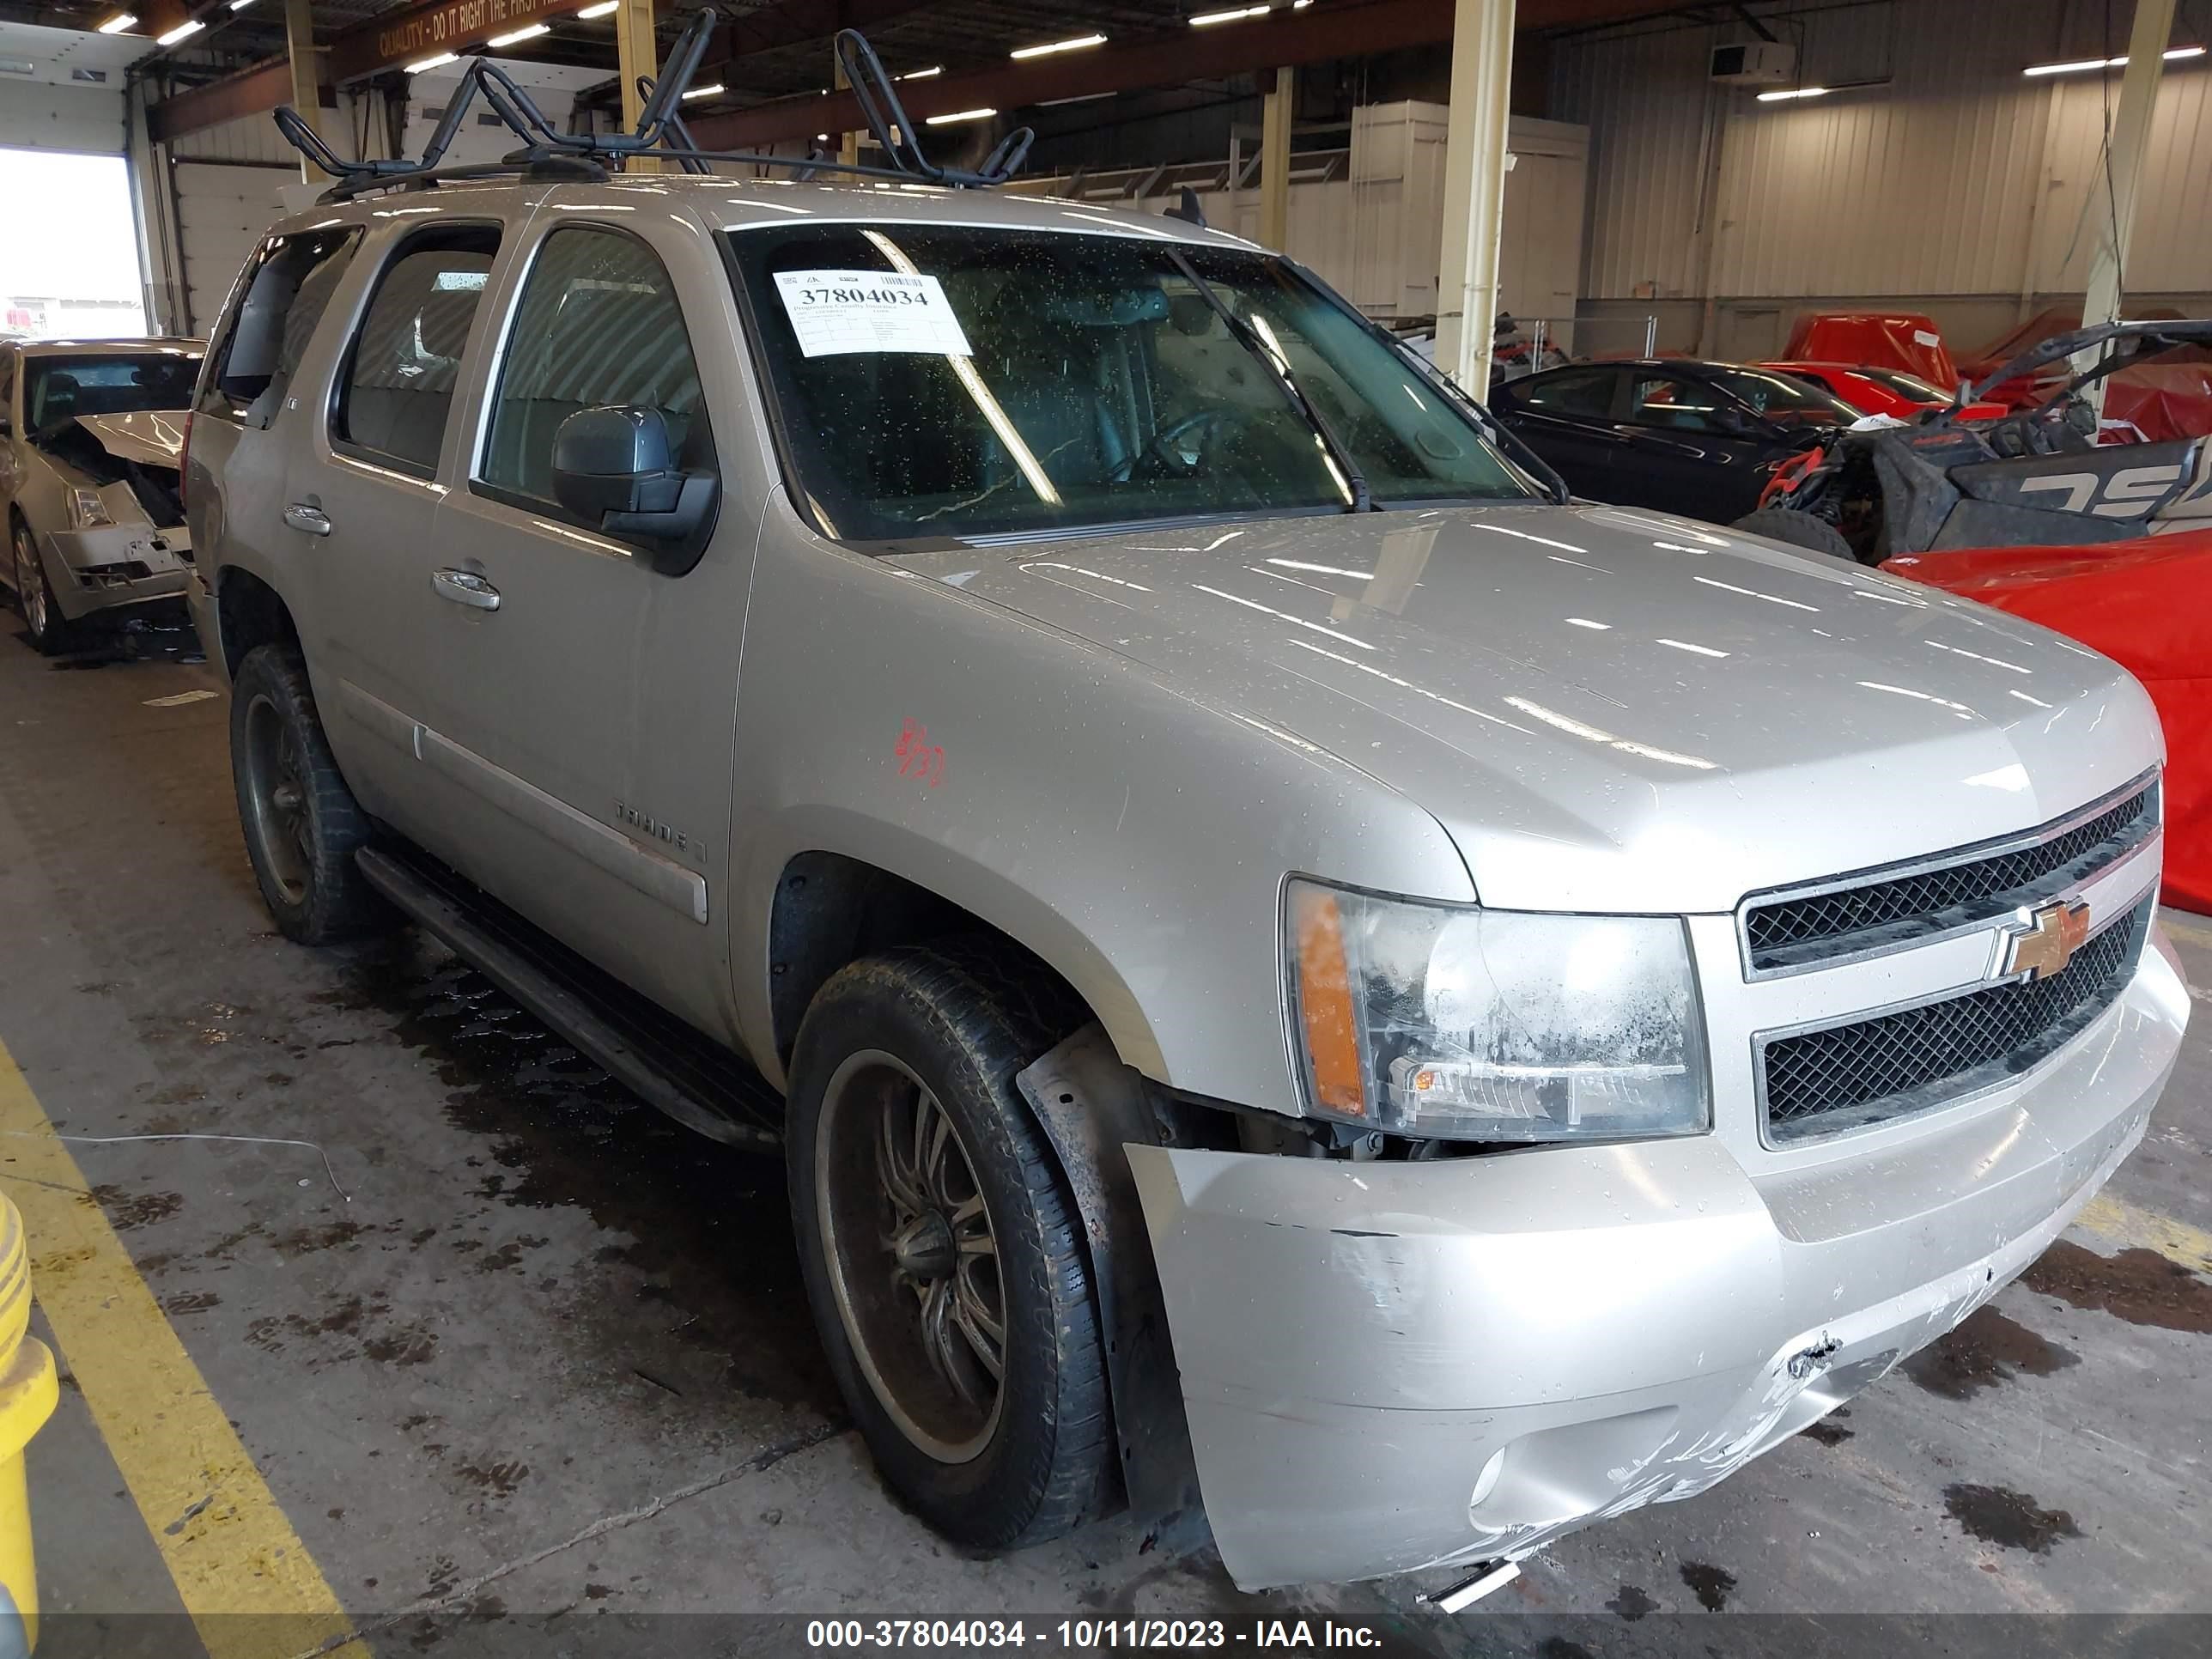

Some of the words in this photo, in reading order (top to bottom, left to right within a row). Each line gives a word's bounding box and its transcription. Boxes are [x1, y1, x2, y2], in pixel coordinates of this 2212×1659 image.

[380, 20, 423, 58] QUALITY
[433, 11, 446, 42] DO
[448, 8, 456, 36] IT
[459, 0, 484, 33] RIGHT
[489, 0, 507, 23] THE
[799, 288, 928, 307] 37804034
